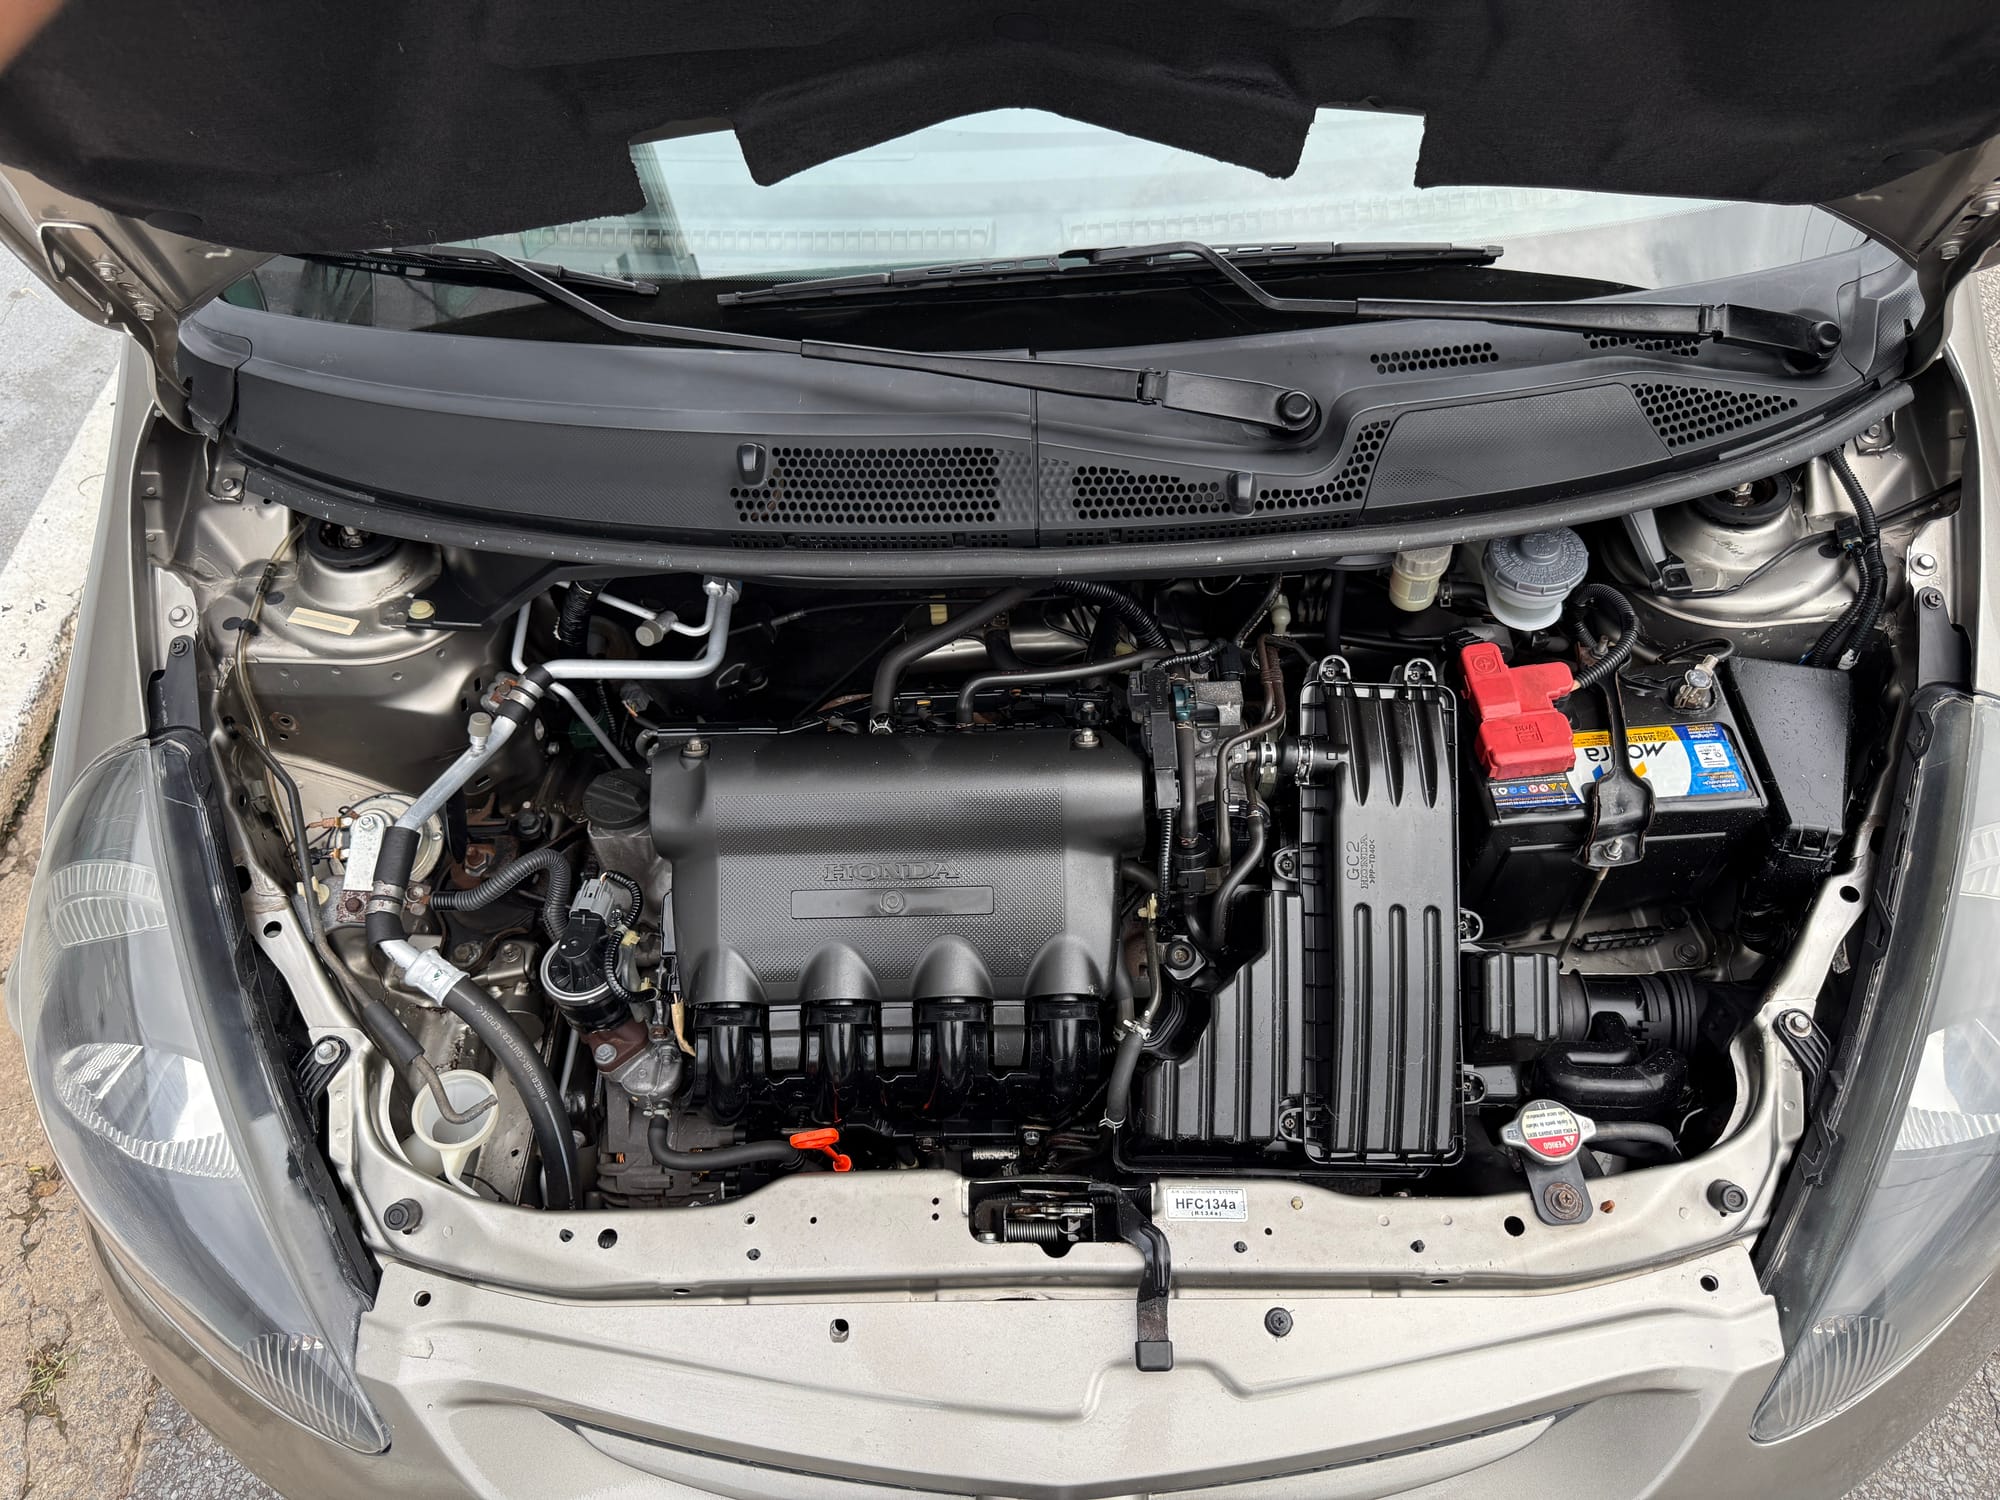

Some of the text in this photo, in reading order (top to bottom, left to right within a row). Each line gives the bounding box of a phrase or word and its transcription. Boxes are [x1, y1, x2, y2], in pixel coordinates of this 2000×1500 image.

[1346, 841, 1360, 880] GC2
[1360, 833, 1369, 890] HONDA
[823, 861, 960, 882] HONDA
[1543, 1140, 1566, 1150] PERIGO
[1175, 1198, 1236, 1210] HFC134a
